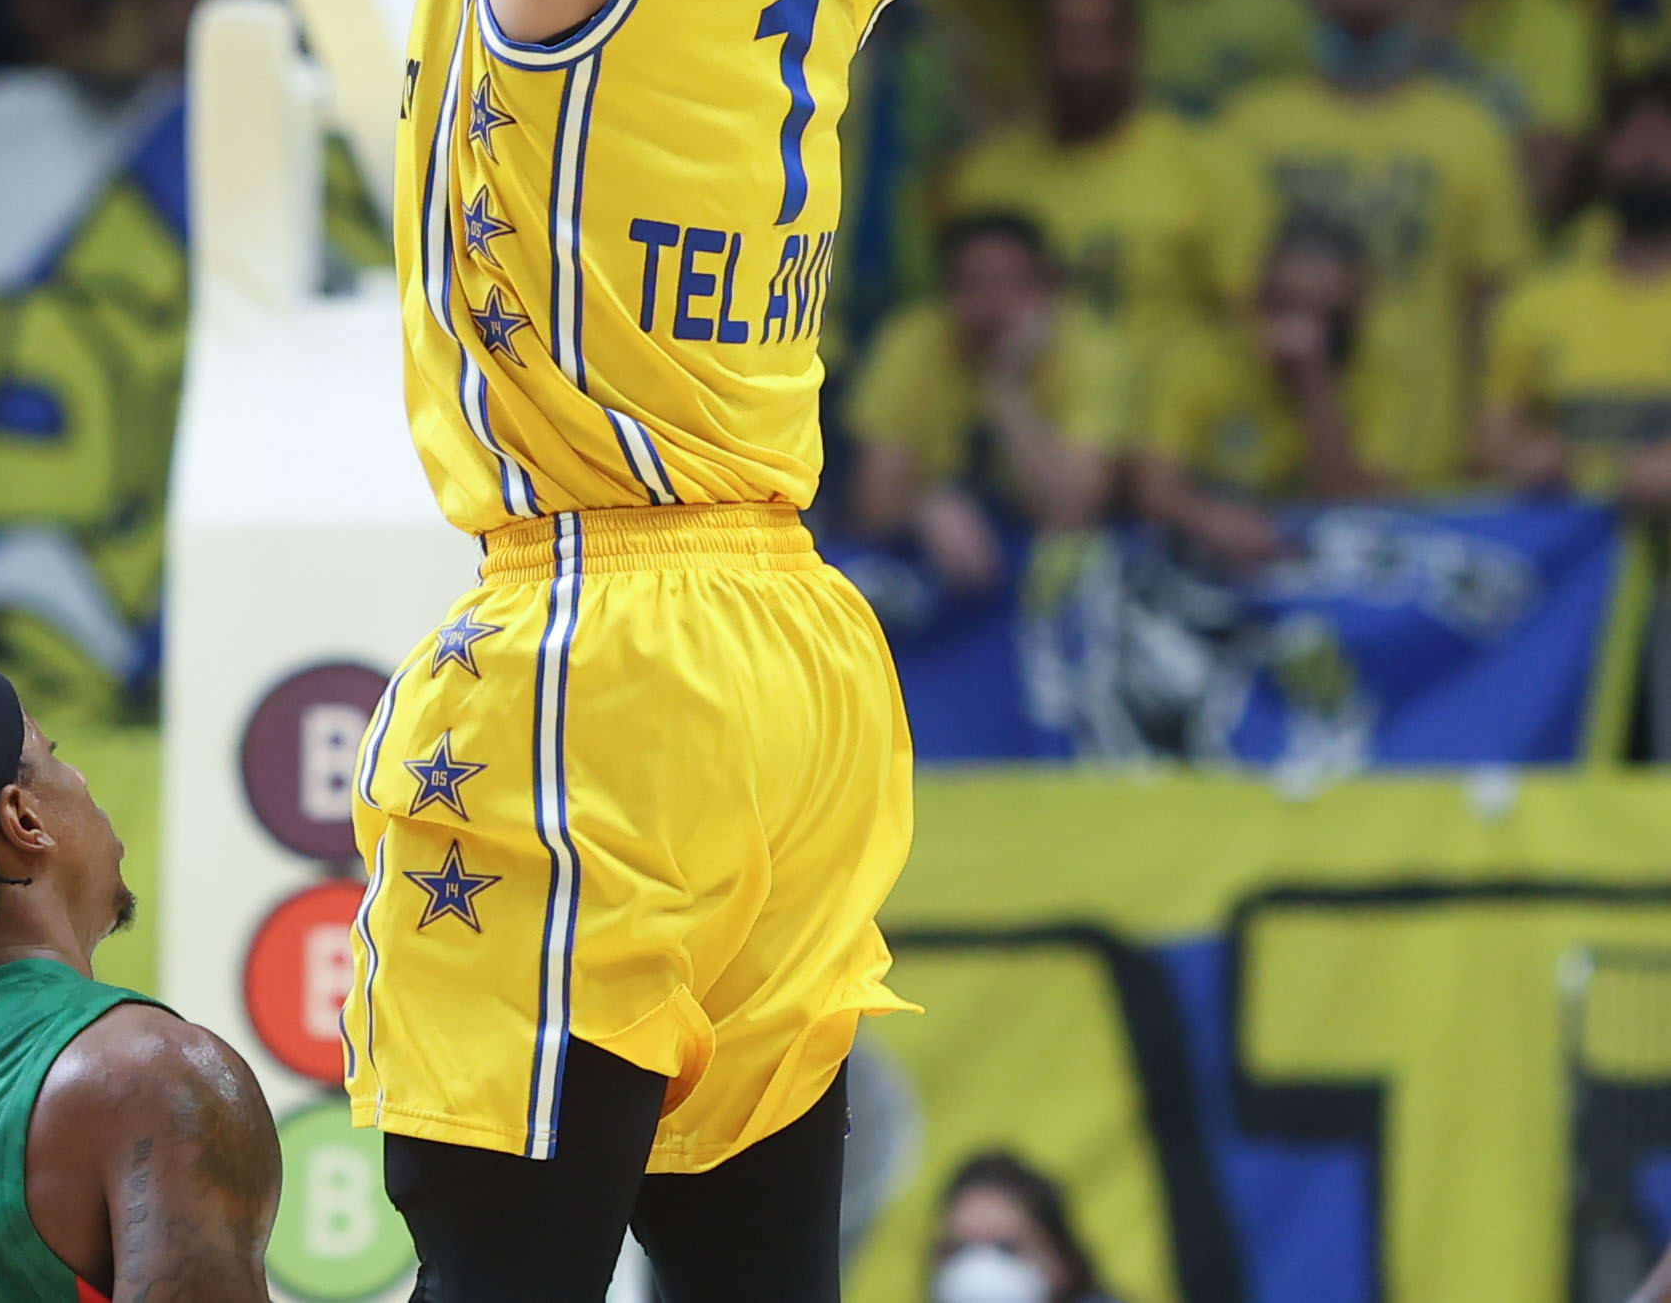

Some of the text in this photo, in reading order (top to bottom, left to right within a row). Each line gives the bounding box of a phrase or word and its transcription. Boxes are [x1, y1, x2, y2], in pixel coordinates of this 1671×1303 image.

[630, 218, 749, 344] TEL
[297, 701, 368, 822] B
[431, 770, 448, 787] 05
[445, 882, 459, 898] 14
[304, 1143, 378, 1260] B
